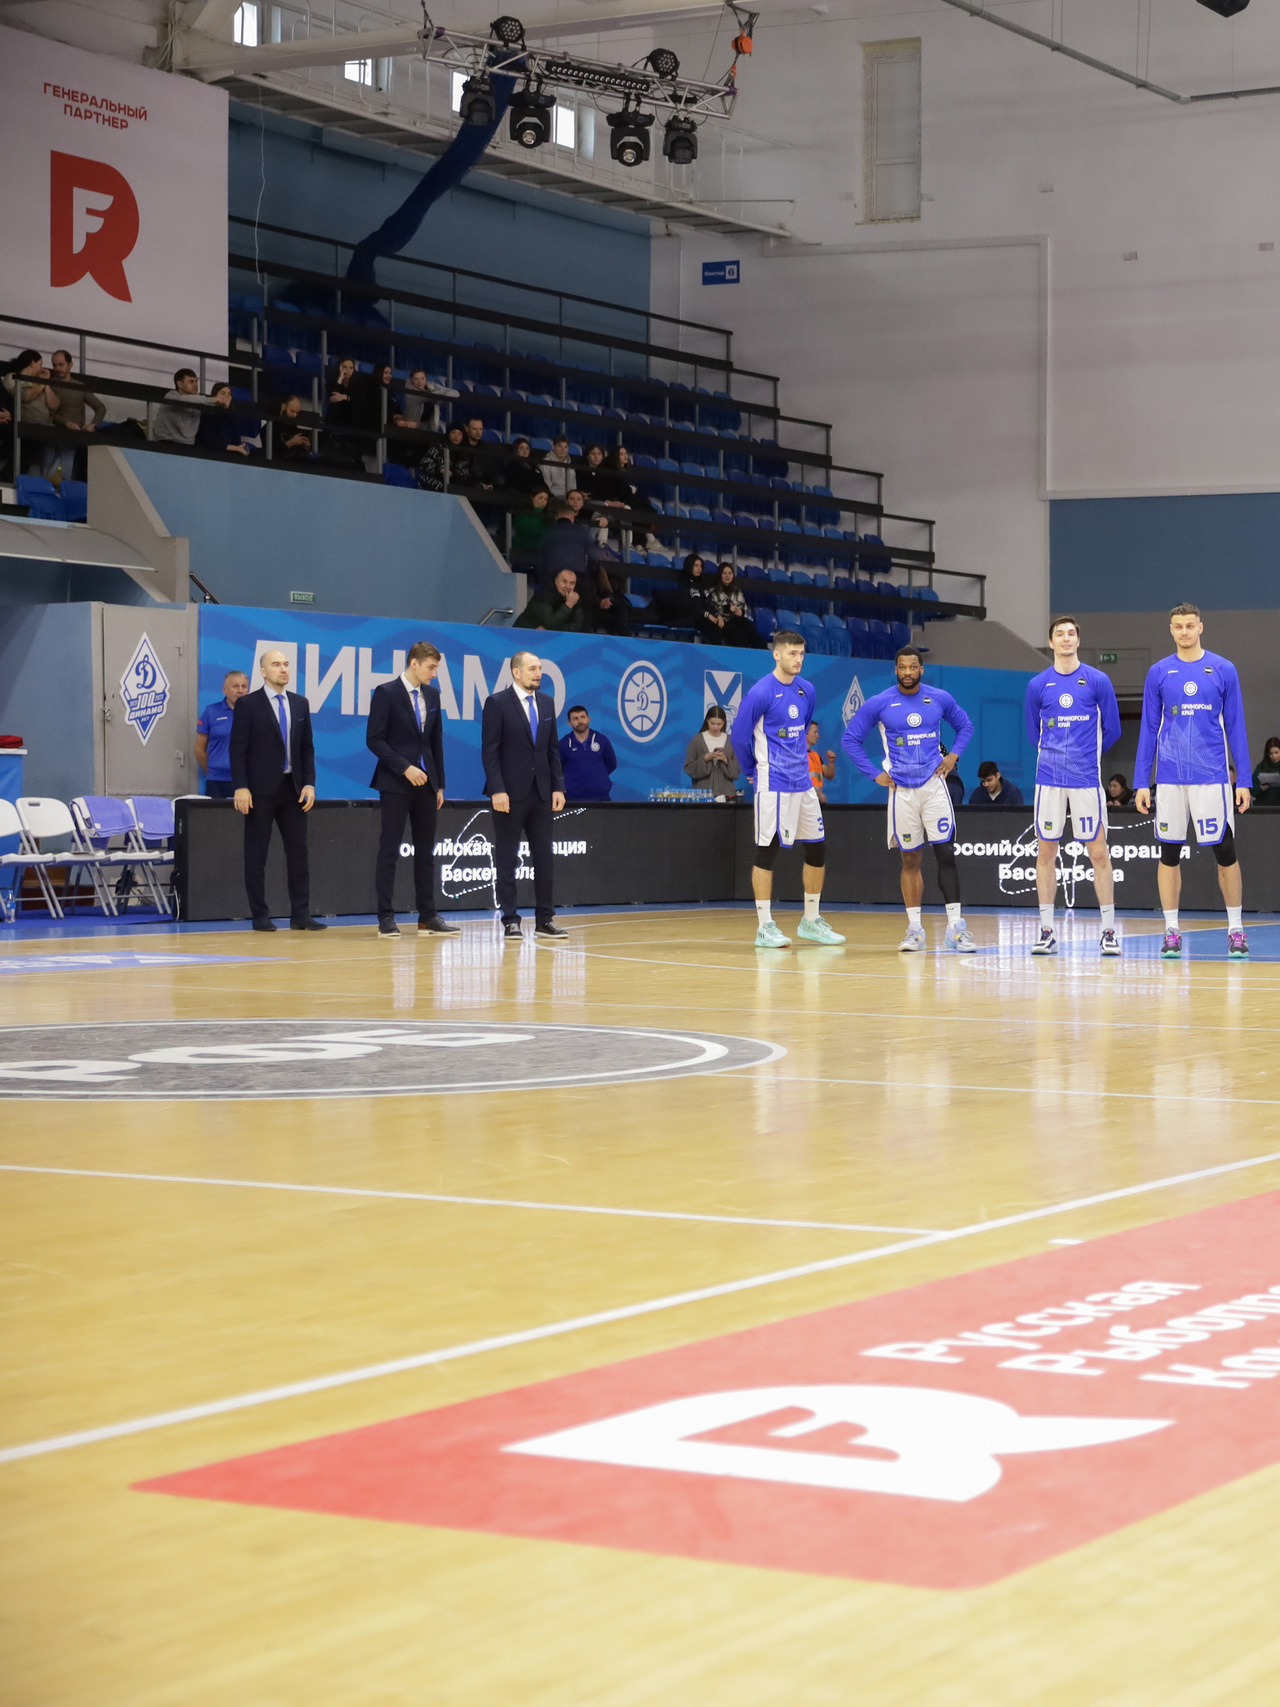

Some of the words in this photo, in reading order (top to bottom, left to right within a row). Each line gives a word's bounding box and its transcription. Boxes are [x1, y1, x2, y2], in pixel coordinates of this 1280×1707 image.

[43, 82, 148, 121] ГЕНЕРАЛЬНЫЙ
[64, 103, 129, 130] ПАРТНЕР
[816, 816, 825, 832] 3
[937, 817, 950, 833] 6
[1079, 816, 1093, 833] 11
[1197, 818, 1219, 836] 15
[859, 1280, 1202, 1364] Русская
